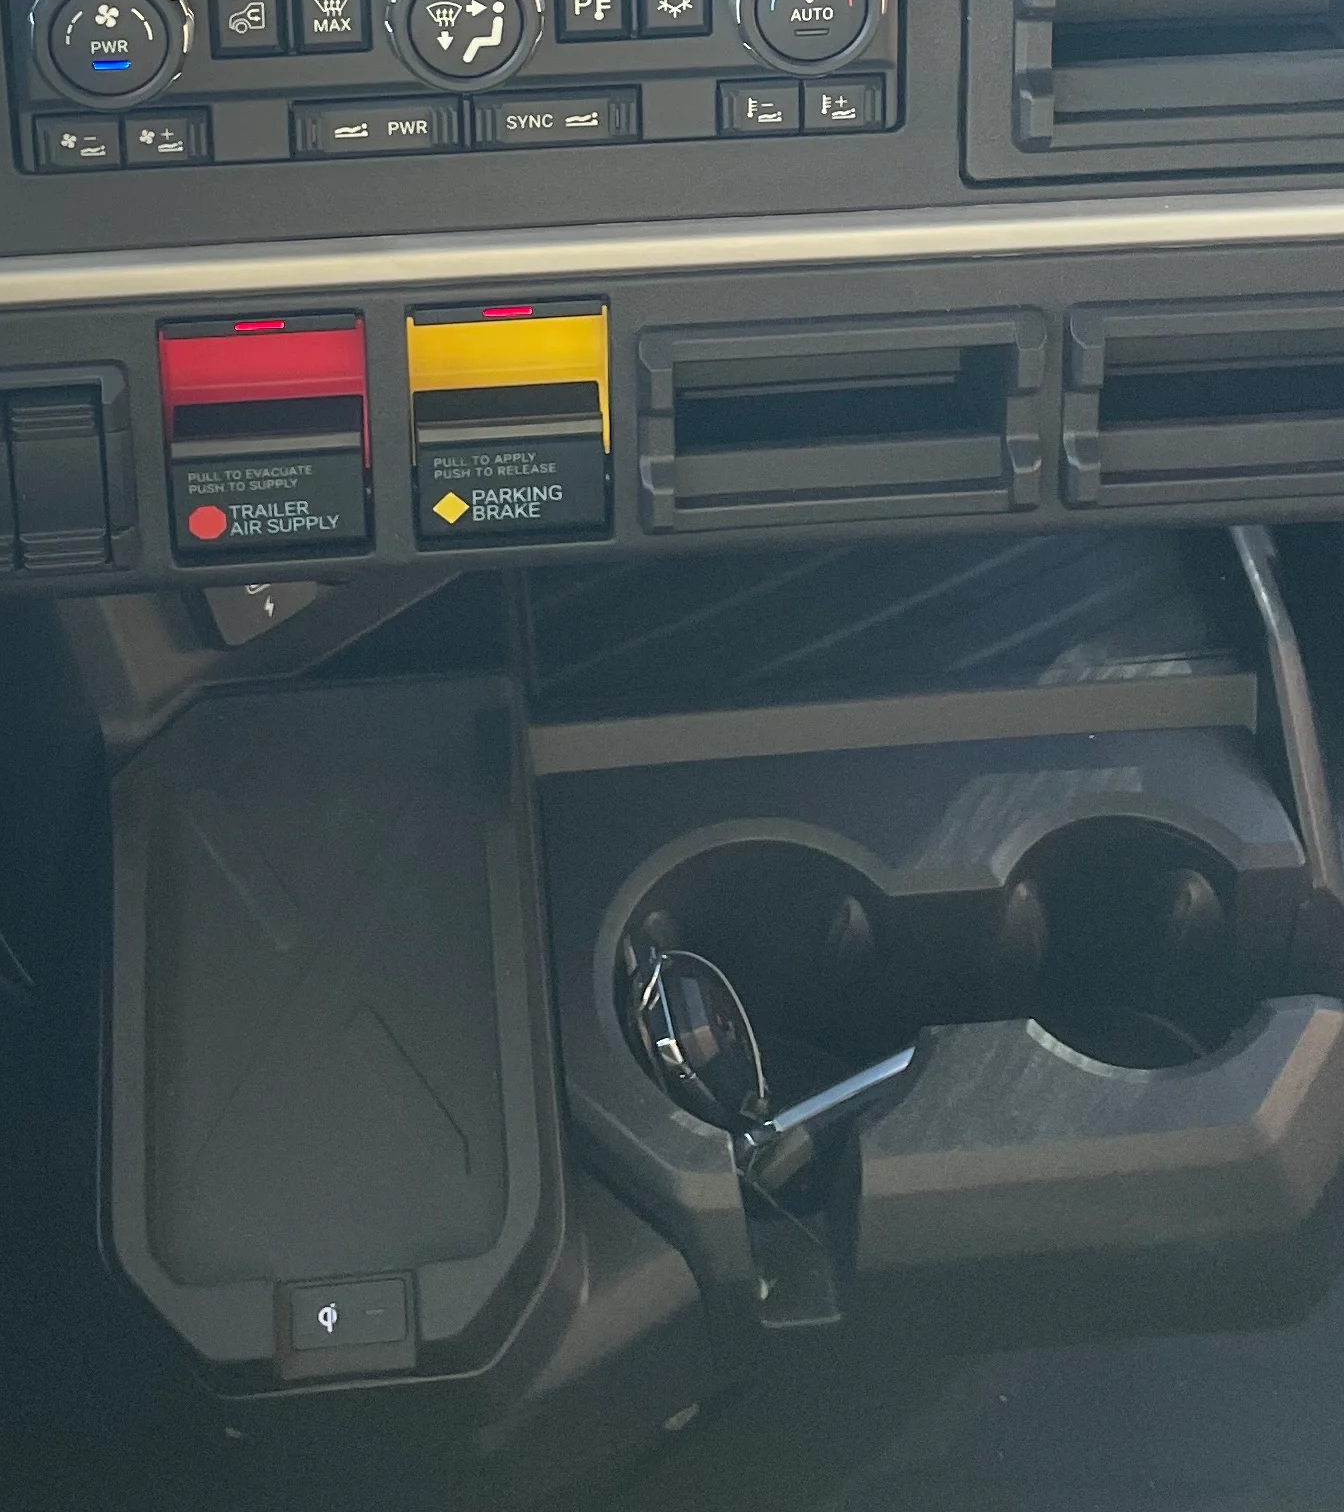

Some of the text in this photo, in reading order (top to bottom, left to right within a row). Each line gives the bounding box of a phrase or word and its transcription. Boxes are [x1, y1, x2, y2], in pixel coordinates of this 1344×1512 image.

[790, 6, 834, 22] AUTO
[313, 17, 352, 33] MAX
[90, 39, 129, 55] PWR
[387, 120, 428, 136] PWR
[506, 113, 554, 130] SYNC
[433, 452, 537, 468] PULL TO APPLY
[187, 464, 313, 483] PULL TO EVACUATE
[434, 462, 557, 480] PUSH TO RELEASE
[188, 478, 299, 495] PUSH TO SUPPLY
[472, 484, 563, 506] PARKING
[228, 500, 310, 520] TRAILER
[472, 501, 542, 522] BRAKE
[229, 514, 340, 537] AIR SUPPLY
